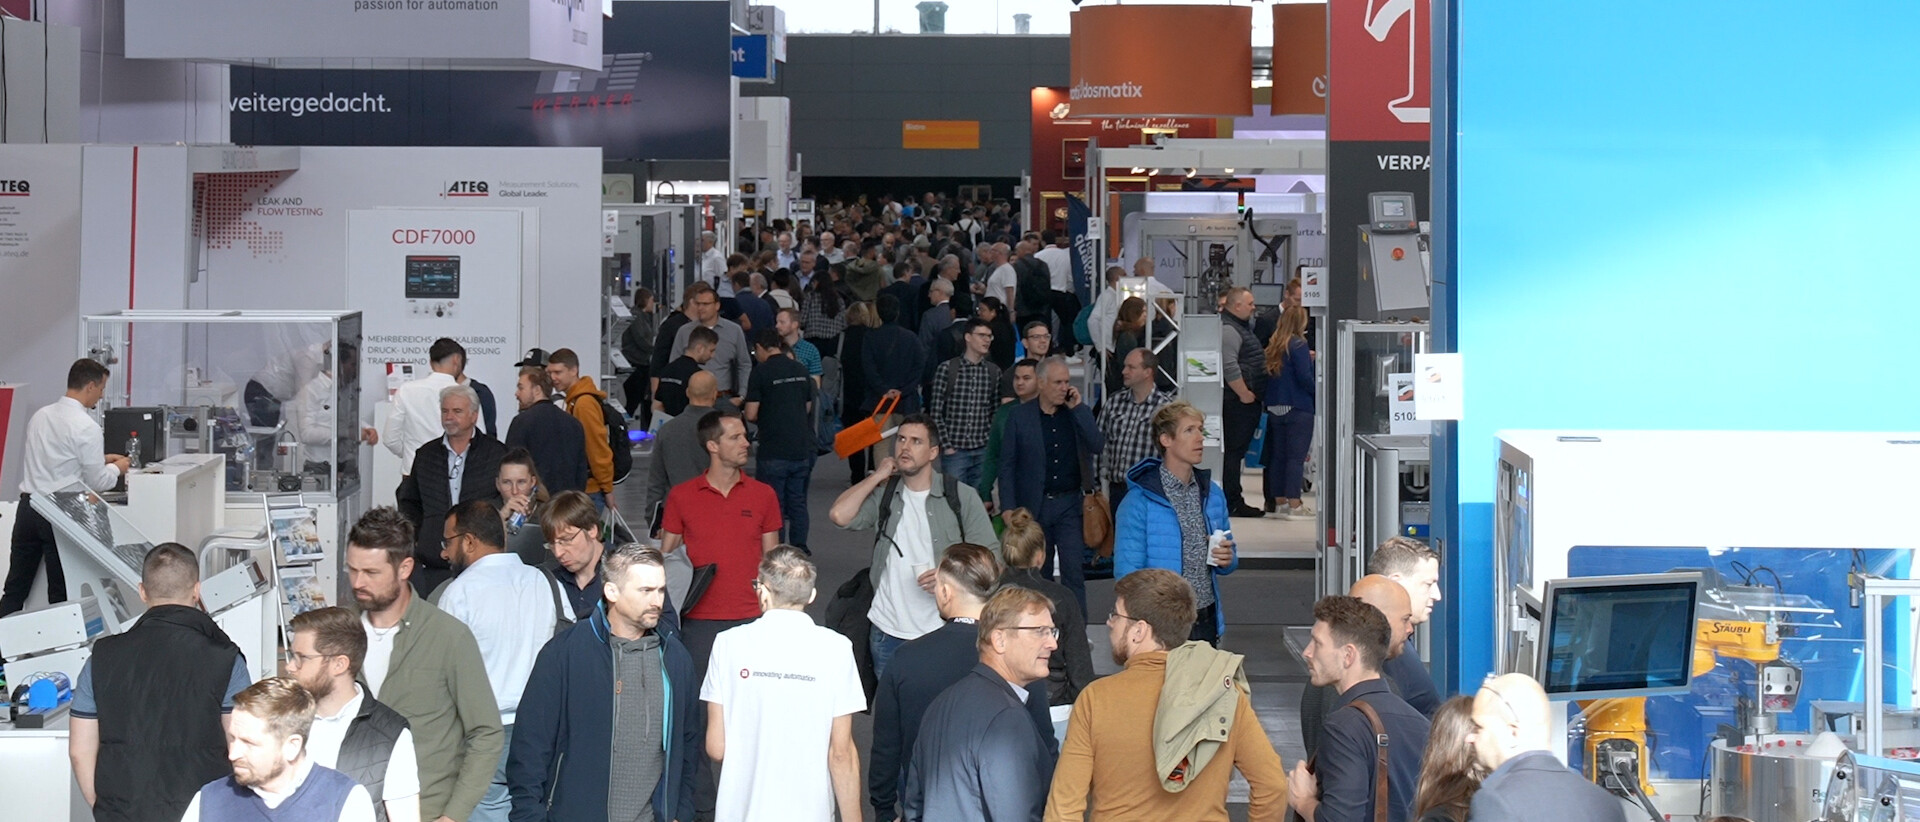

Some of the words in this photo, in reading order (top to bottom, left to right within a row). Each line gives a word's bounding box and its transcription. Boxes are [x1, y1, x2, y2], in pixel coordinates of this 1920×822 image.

[354, 0, 402, 12] passion
[406, 0, 424, 10] for
[428, 0, 498, 10] automation
[1377, 155, 1430, 170] VERPA
[448, 181, 489, 193] ATEQ
[498, 190, 521, 198] Global
[523, 190, 548, 198] Leader.
[257, 197, 281, 206] LEAK
[282, 197, 303, 206] AND
[257, 208, 284, 217] FLOW
[286, 208, 323, 217] TESTING
[392, 229, 476, 244] CDF7000
[367, 336, 507, 344] MEHRBEREICHS-KALIBRATOR
[402, 347, 421, 355] UND
[423, 347, 501, 355] VESSUNG
[1711, 622, 1751, 634] STÄUBLI
